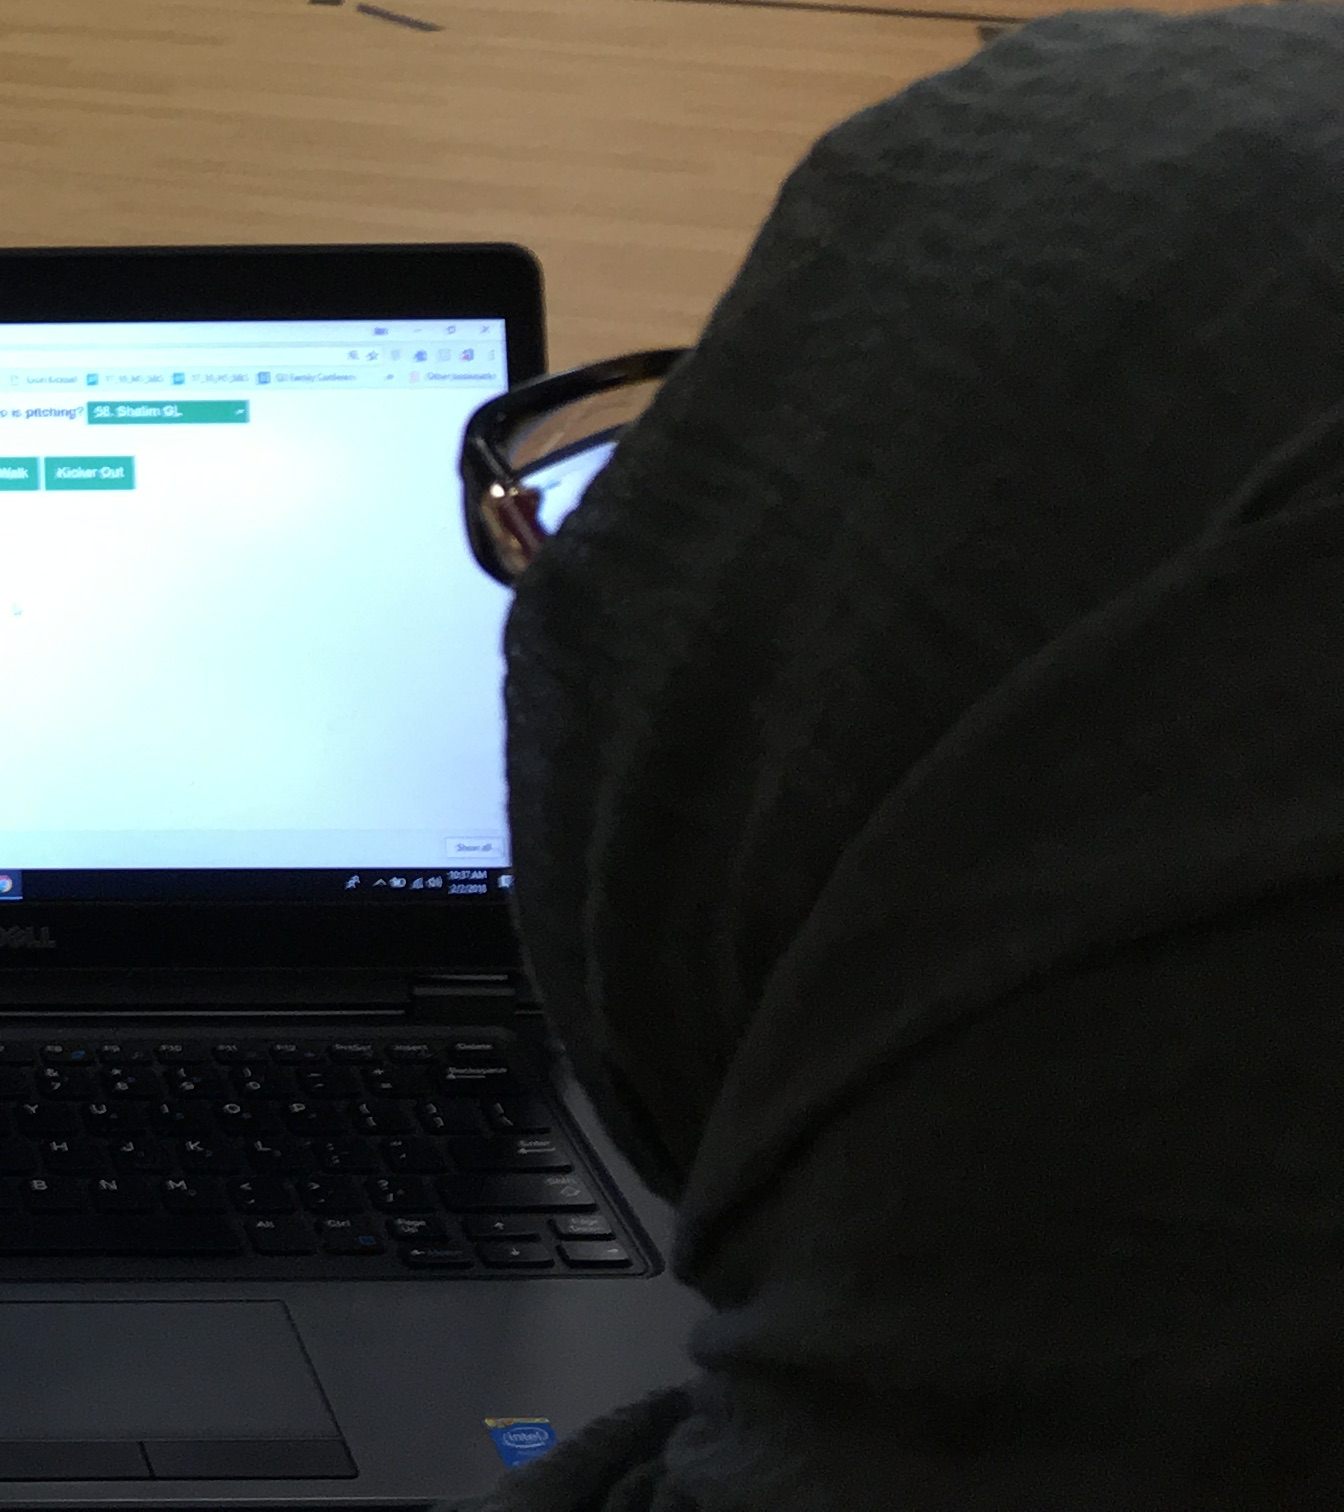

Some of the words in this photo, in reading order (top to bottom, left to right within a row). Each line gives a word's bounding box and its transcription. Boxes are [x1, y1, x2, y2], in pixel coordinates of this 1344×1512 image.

[13, 407, 22, 418] is
[25, 406, 84, 420] pitching?
[55, 466, 97, 480] Kicker
[99, 466, 125, 479] Out
[455, 843, 480, 853] Show
[471, 870, 488, 880] AM
[23, 1103, 39, 1115] Y
[89, 1103, 108, 1115] U
[222, 1103, 241, 1115] O
[288, 1102, 306, 1114] P
[50, 1141, 69, 1152] H
[120, 1141, 136, 1152] J
[185, 1140, 204, 1151] K
[253, 1141, 271, 1152] L
[31, 1179, 48, 1191] B
[99, 1179, 118, 1191] N
[165, 1179, 187, 1191] M
